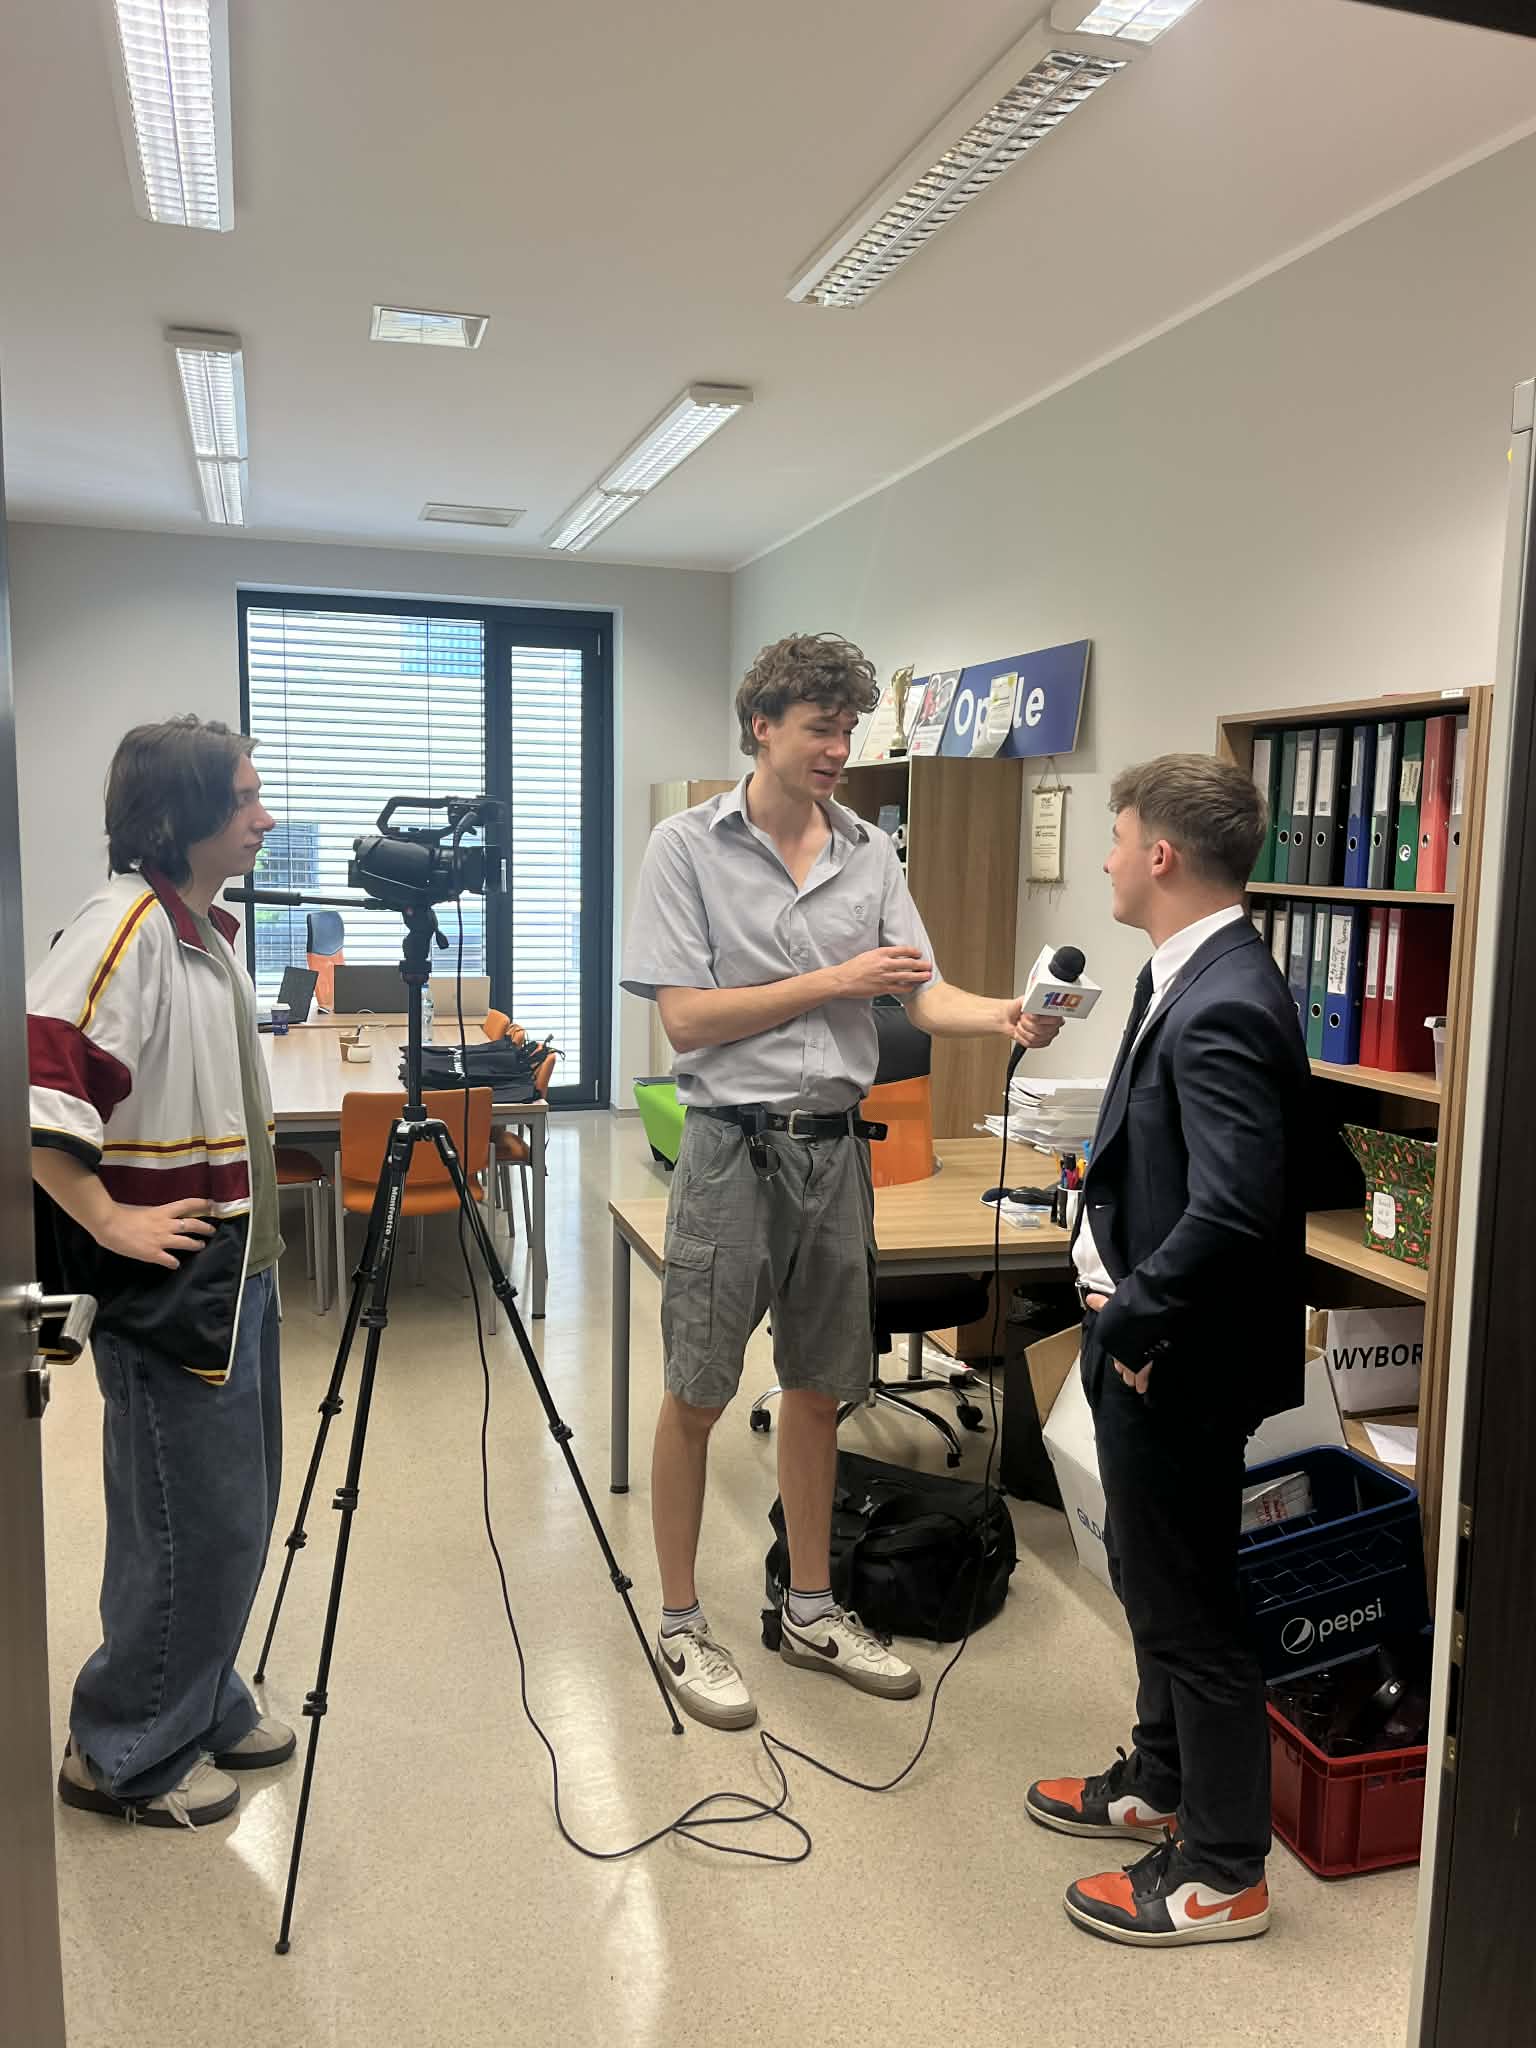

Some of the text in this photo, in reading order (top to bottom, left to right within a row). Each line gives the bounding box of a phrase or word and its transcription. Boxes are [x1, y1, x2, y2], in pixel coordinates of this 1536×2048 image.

[954, 676, 1045, 738] Ople
[385, 1186, 399, 1236] Manfrotto
[1333, 1343, 1423, 1371] WYBOR
[1319, 1597, 1382, 1643] pepsi
